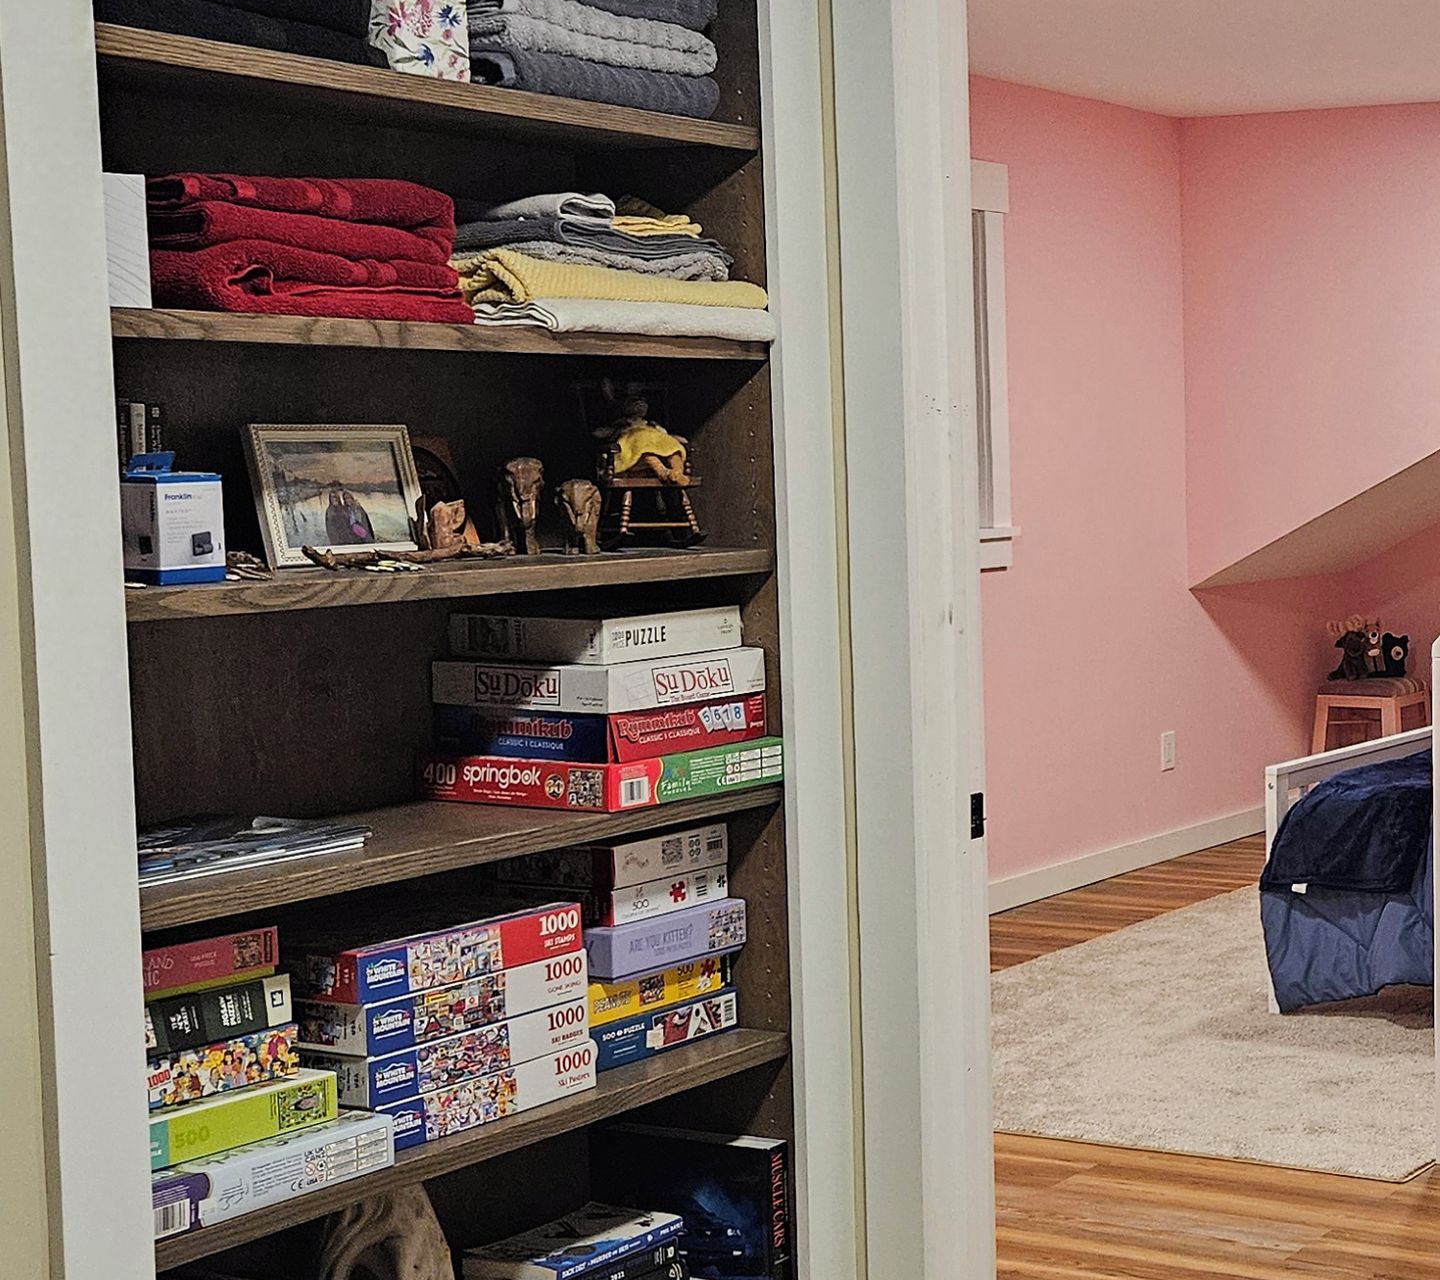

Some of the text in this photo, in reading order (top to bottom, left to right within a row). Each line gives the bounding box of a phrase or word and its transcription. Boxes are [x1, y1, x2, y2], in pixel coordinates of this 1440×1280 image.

[164, 493, 193, 501] Franklin
[625, 625, 666, 647] PUZZLE
[703, 711, 710, 723] 5
[713, 709, 721, 720] 6
[734, 706, 742, 720] 8
[617, 709, 696, 742] Rummikub
[498, 738, 564, 750] CLASSIC CLASSIQUE
[639, 727, 701, 744] CLASSIC CLASSIQUE
[424, 763, 456, 785] 400
[463, 762, 541, 789] springbok
[661, 777, 691, 791] Family
[632, 898, 650, 911] 500
[539, 909, 578, 936] 1000
[555, 933, 576, 946] STAMPS
[367, 969, 405, 984] MOUNTAIN
[374, 962, 396, 974] WHITE
[545, 956, 582, 982] 1000
[226, 993, 237, 1027] PUZZLE
[593, 990, 632, 1014] PEANUTS
[218, 996, 230, 1027] JIGSAW
[381, 1013, 402, 1024] WHITE
[548, 1005, 585, 1032] 1000
[373, 1020, 410, 1035] MOUNTAIN
[602, 1022, 646, 1042] 500 PUZZLE
[554, 1048, 591, 1076] 1000
[148, 1069, 171, 1090] 1000
[376, 1073, 414, 1089] MOUNTAIN
[383, 1067, 406, 1078] WHITE
[174, 1126, 210, 1148] 500
[771, 1152, 785, 1248] MUSCLE CARS
